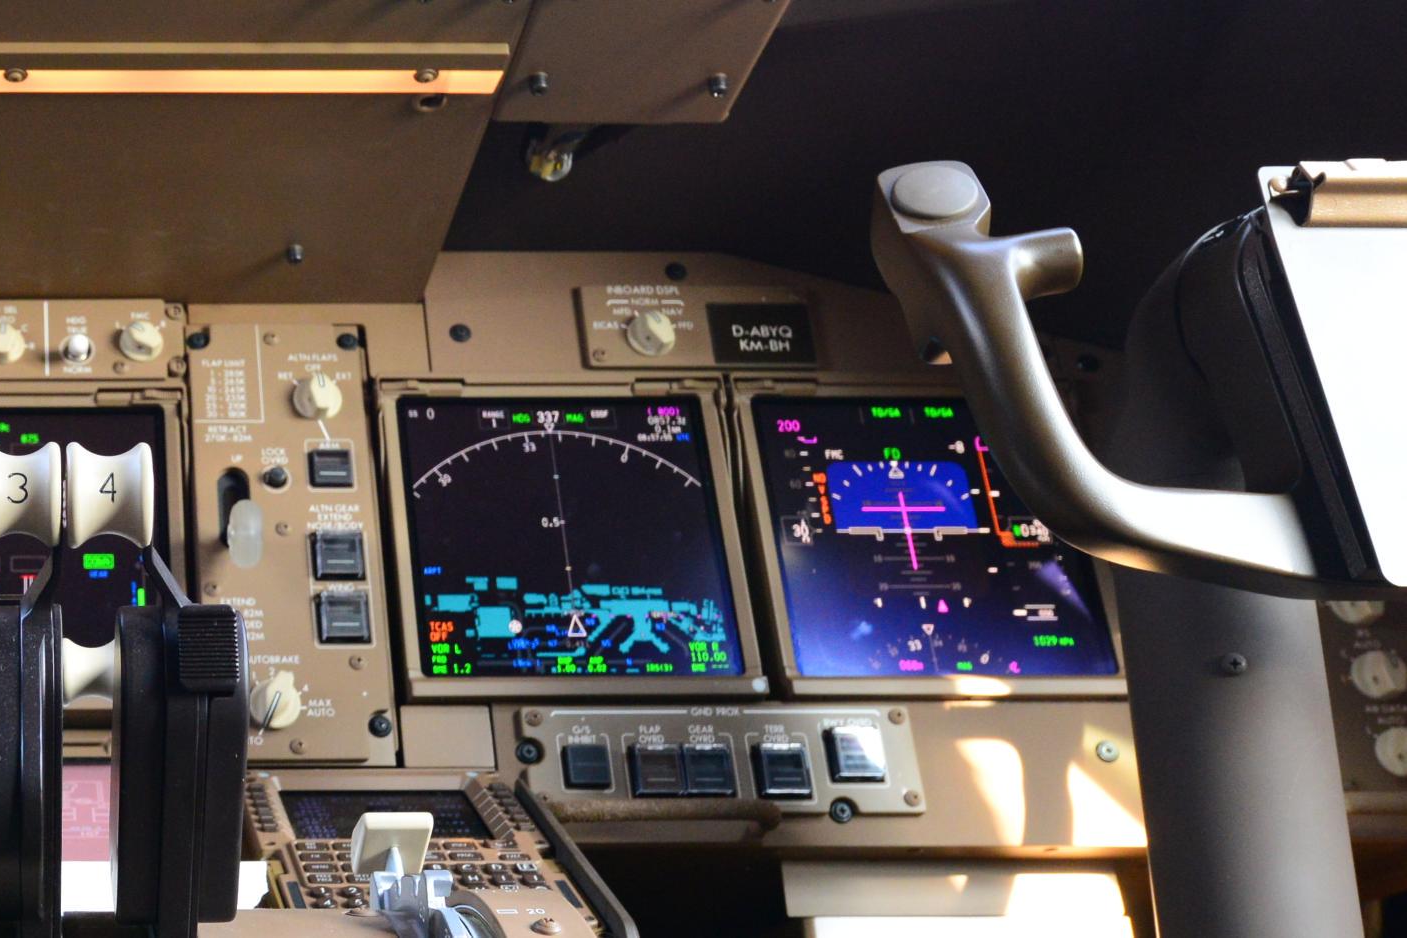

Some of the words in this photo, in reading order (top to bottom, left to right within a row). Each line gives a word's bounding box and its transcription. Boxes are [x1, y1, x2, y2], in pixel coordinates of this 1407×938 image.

[606, 285, 654, 295] INBOARD
[731, 324, 793, 339] D-ABYQ
[739, 339, 791, 352] KM-BH
[426, 407, 435, 420] 0
[536, 410, 560, 424] 337
[777, 419, 801, 433] 200
[261, 448, 285, 456] LOCK
[883, 446, 901, 461] FD
[6, 472, 29, 504] 3
[98, 472, 117, 503] 4
[308, 504, 332, 513] ALTN
[334, 504, 360, 513] GEAR
[317, 513, 353, 521] EXTEND
[307, 521, 364, 531] NOSE/BODY
[429, 621, 454, 633] TCAS
[429, 631, 448, 642] OFF
[248, 655, 300, 664] UTOBRAKE
[690, 651, 727, 663] 110.00
[308, 699, 332, 707] MAX
[306, 708, 336, 717] AUTO
[639, 725, 661, 734] FLAP
[688, 725, 714, 734] GEAR
[765, 725, 785, 734] TERR
[248, 737, 264, 745] TO
[638, 735, 665, 743] OVRD
[689, 735, 715, 743] OVRD
[763, 735, 789, 743] OVRD
